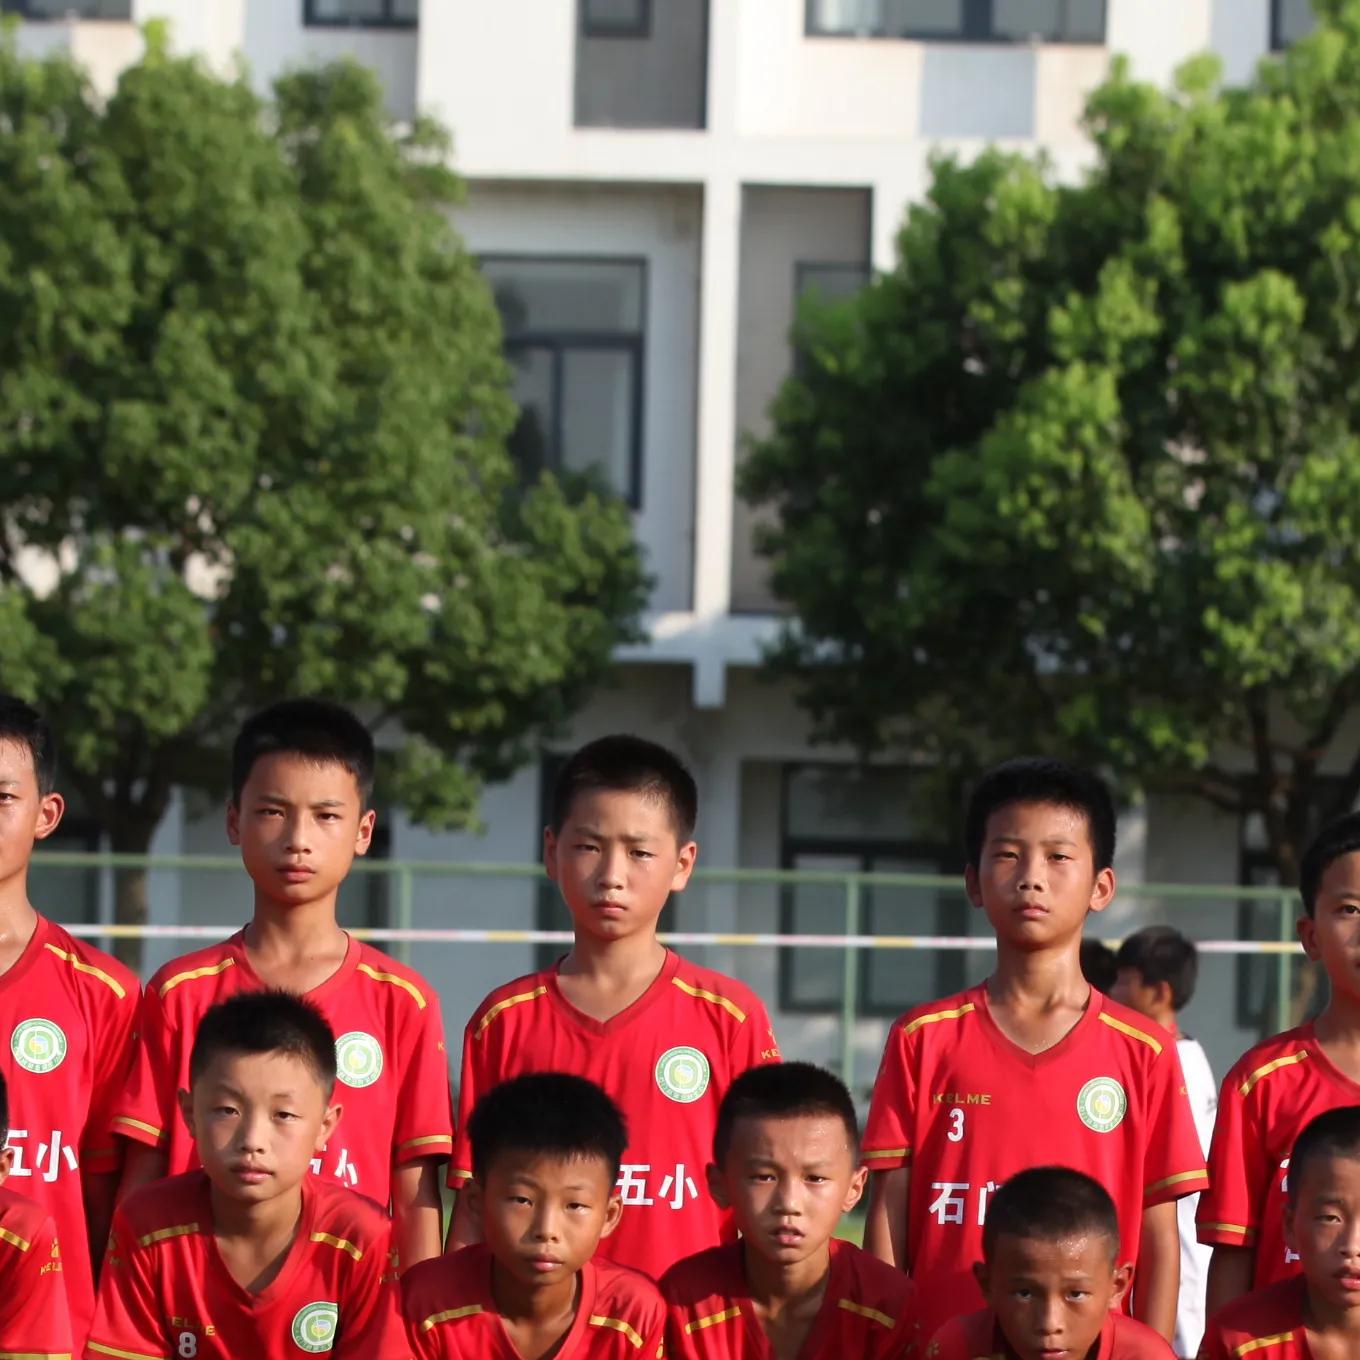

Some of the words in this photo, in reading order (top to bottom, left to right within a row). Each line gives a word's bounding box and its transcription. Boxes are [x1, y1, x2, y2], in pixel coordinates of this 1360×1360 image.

[946, 1107, 965, 1142] 3
[616, 1163, 699, 1210] 五小
[177, 1331, 198, 1359] 8
